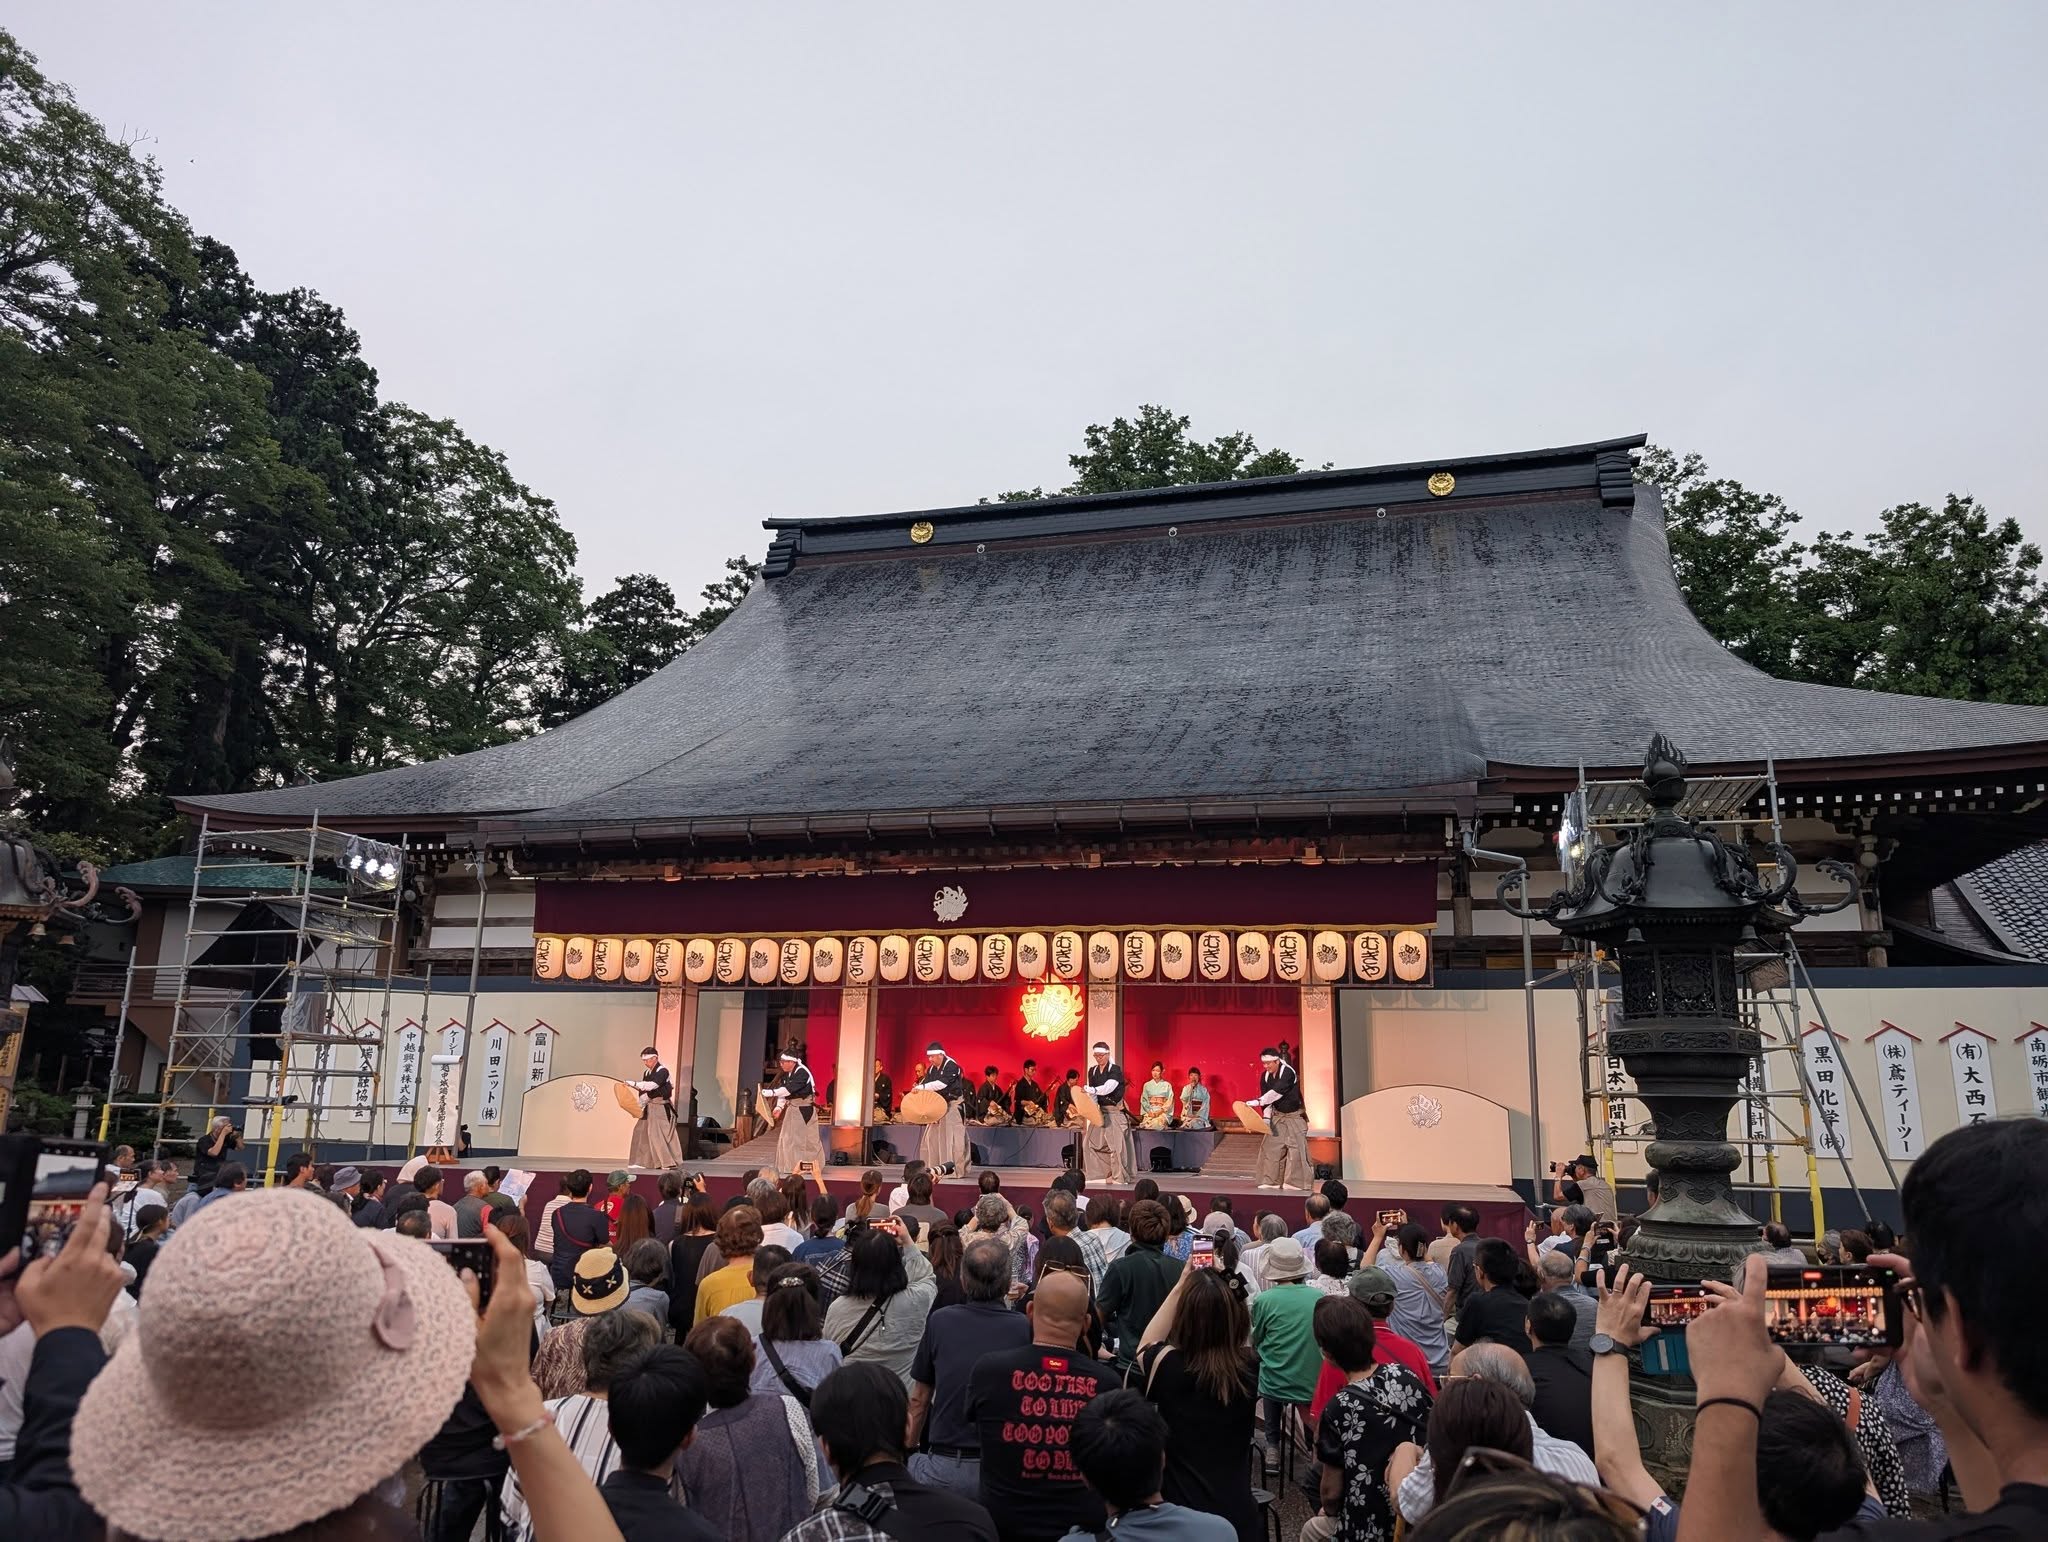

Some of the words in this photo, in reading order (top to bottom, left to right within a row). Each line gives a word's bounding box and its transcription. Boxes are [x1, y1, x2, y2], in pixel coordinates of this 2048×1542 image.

[535, 938, 551, 976] むぎや
[594, 939, 611, 978] むぎや
[655, 940, 671, 981] むぎや
[717, 940, 734, 978] むぎや
[781, 940, 800, 979] むぎや
[849, 940, 866, 978] むぎや
[917, 939, 935, 979] むぎや
[989, 938, 1007, 976] むぎや
[1053, 936, 1072, 974] むぎや
[1125, 935, 1145, 975] むぎや
[1202, 934, 1221, 976] むぎや
[1280, 934, 1299, 975] むぎや
[1360, 935, 1377, 977] むぎや
[398, 1032, 417, 1115] 中越興業株式会社
[530, 1033, 548, 1089] 富山新
[1814, 1046, 1845, 1150] 黒田化学(株)
[1045, 1424, 1072, 1445] YO
